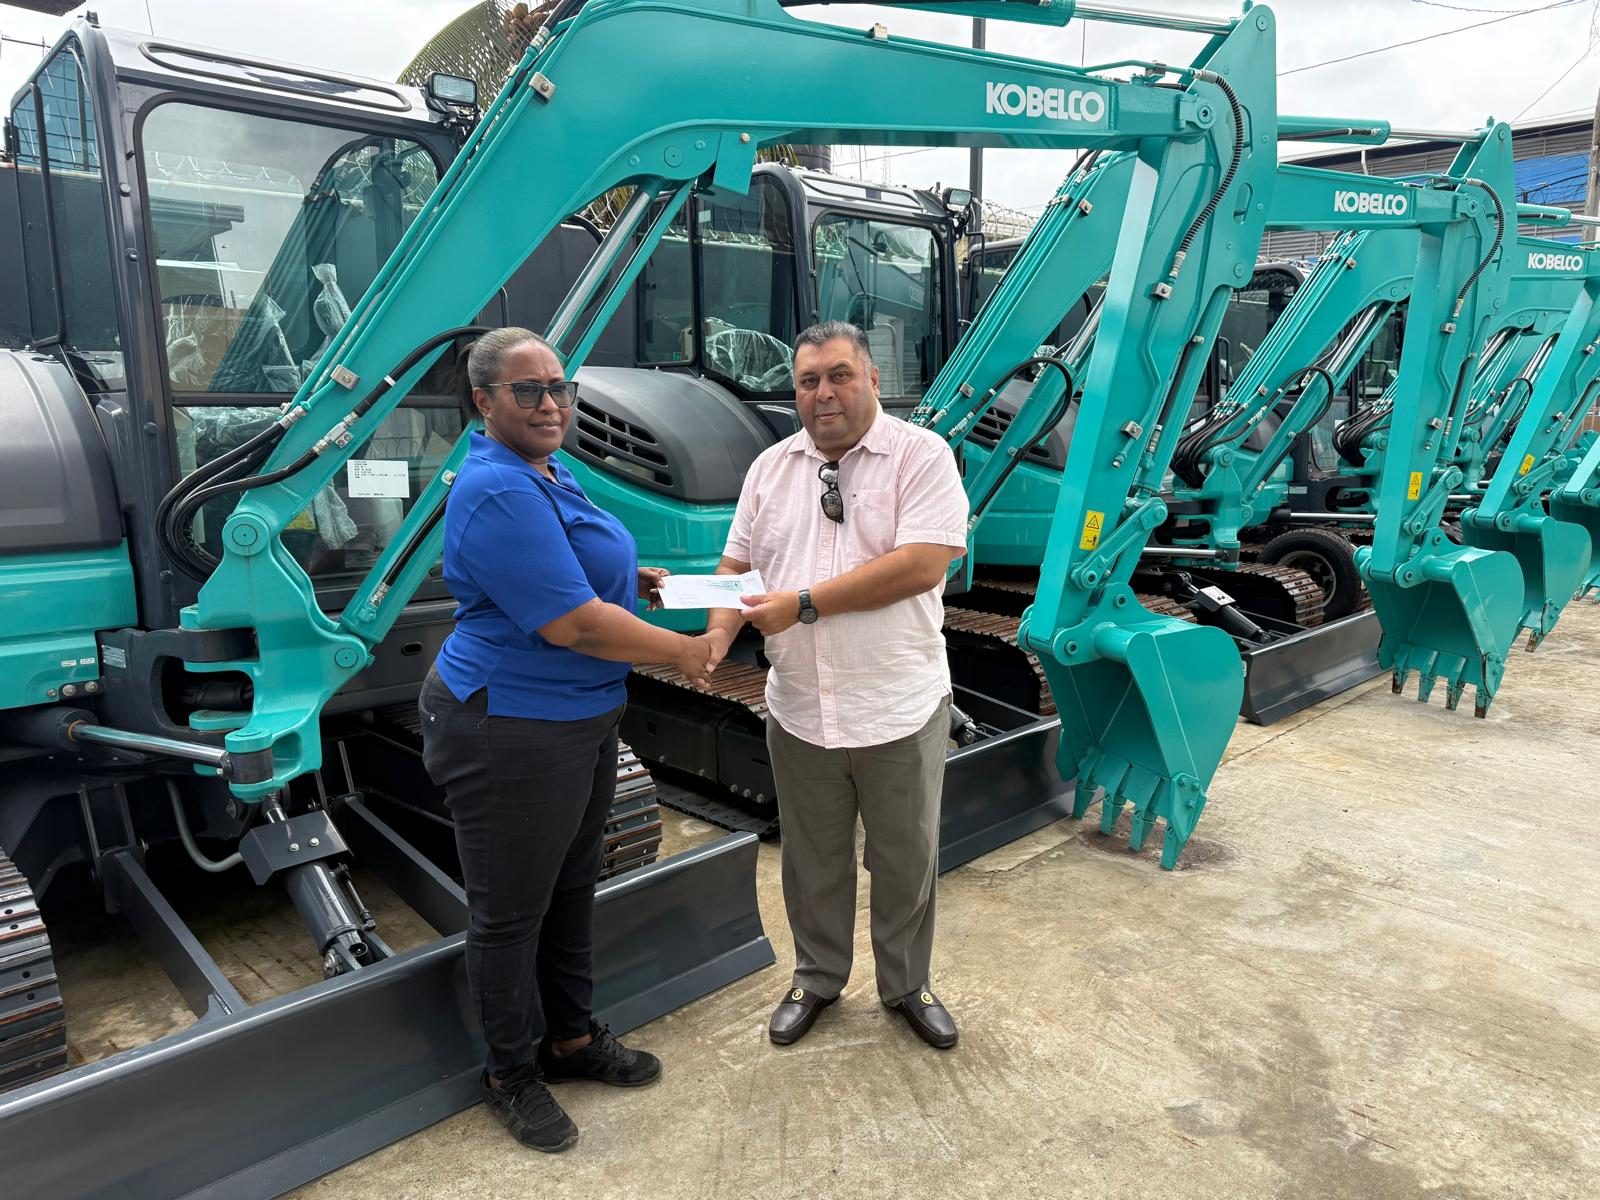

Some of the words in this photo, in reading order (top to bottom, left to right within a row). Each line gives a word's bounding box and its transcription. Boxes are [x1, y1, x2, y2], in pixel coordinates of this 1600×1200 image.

[986, 81, 1105, 122] KOBELCO
[1334, 190, 1408, 216] KOBELCO
[1527, 252, 1583, 271] KOBELCO
